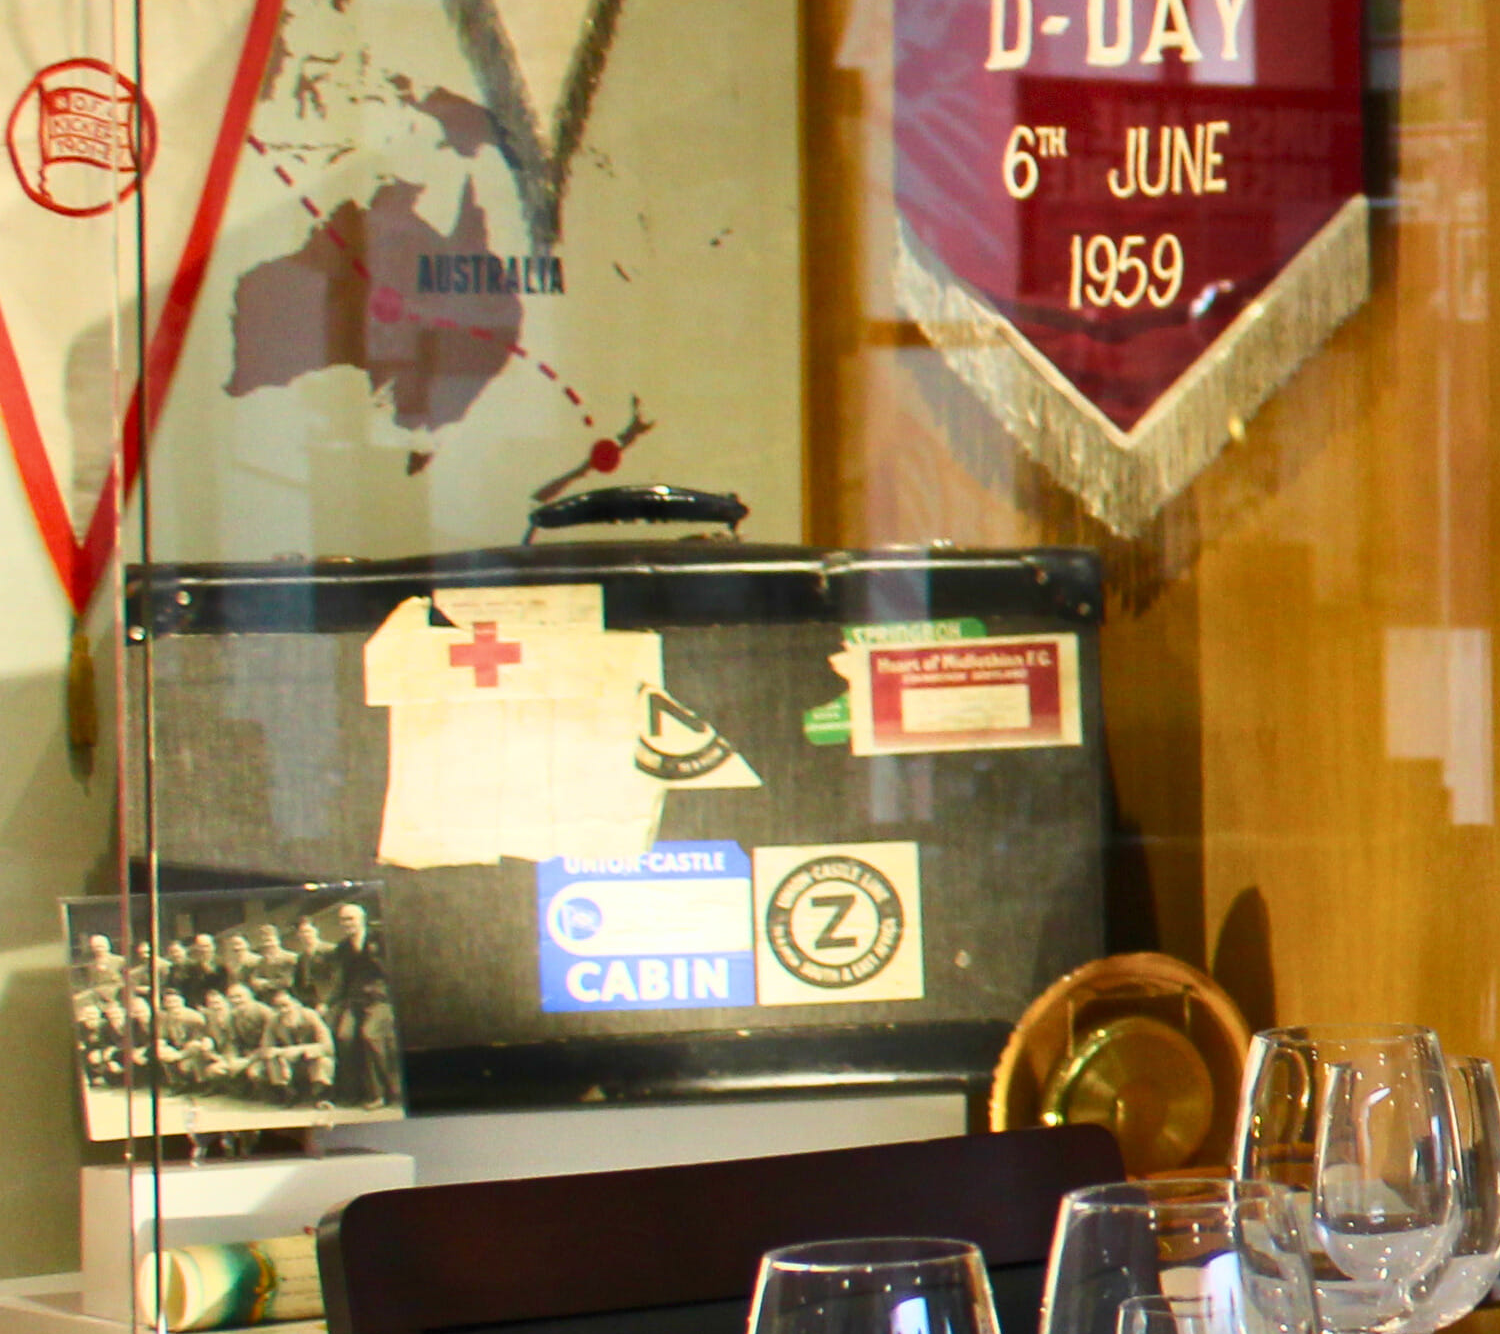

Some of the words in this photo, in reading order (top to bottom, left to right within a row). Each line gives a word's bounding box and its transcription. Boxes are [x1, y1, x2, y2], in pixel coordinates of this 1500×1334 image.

[1003, 123, 1069, 200] 6TH
[1107, 120, 1230, 198] JUNE
[417, 252, 565, 297] AUSTRALIA
[1068, 233, 1184, 310] 1959
[810, 893, 859, 950] Z
[565, 957, 730, 1002] CABIN
